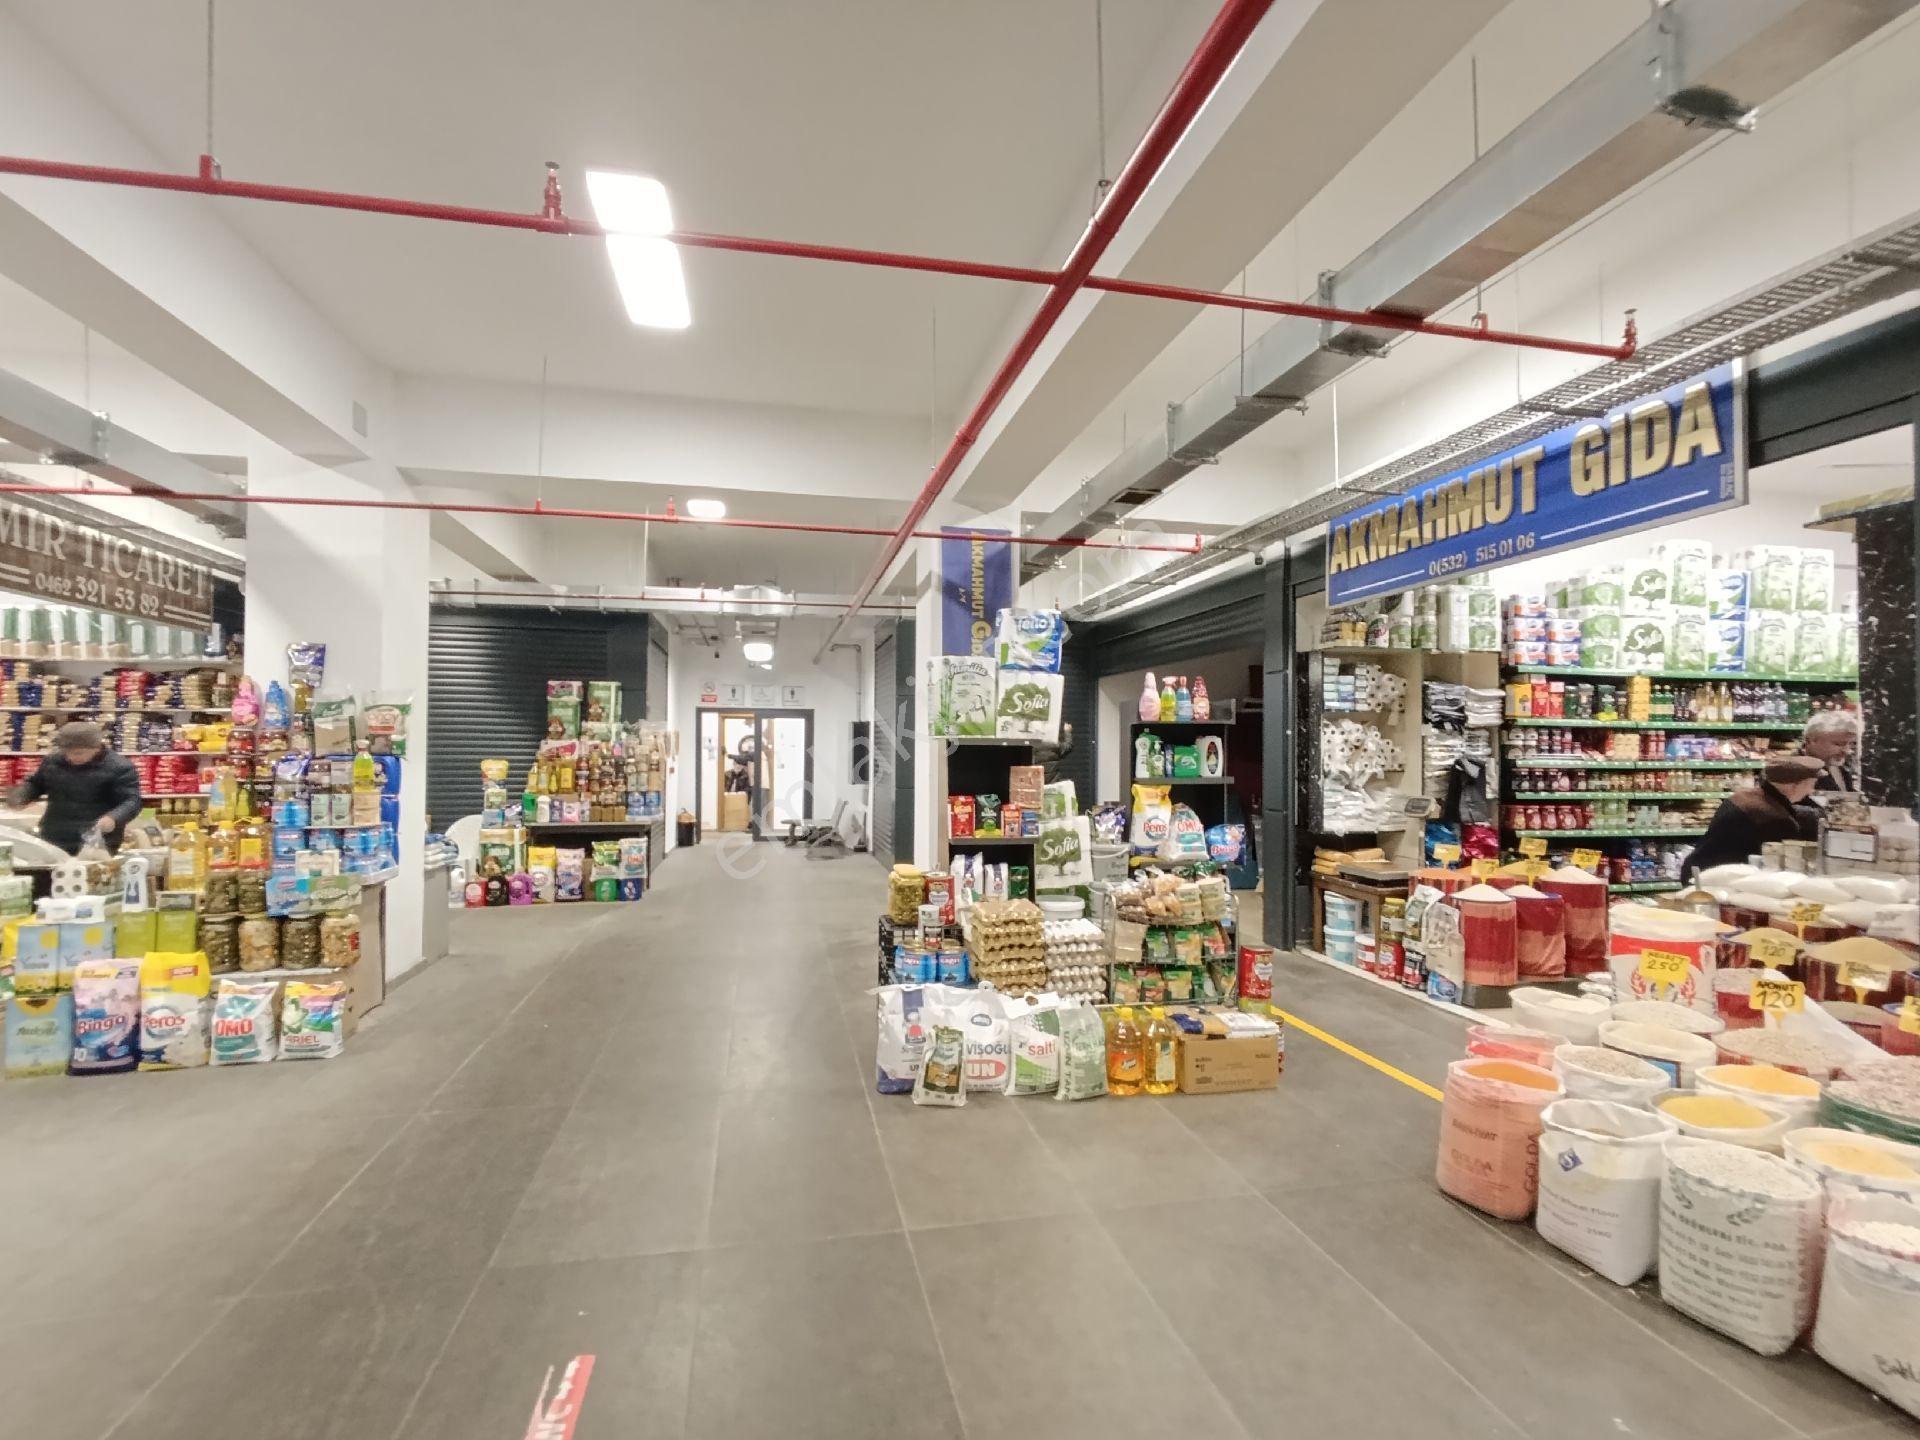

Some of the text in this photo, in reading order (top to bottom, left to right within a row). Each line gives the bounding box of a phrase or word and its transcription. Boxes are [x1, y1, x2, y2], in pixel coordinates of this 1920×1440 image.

[1329, 381, 1723, 575] AKMAHMUT GIDA
[1428, 531, 1536, 576] 0(532) 515 01 06
[75, 575, 107, 606] 321
[139, 592, 160, 617] 82
[1039, 836, 1079, 862] Sofia
[1646, 958, 1681, 972] 250
[1755, 989, 1796, 1009] 120
[214, 1018, 253, 1037] OMO
